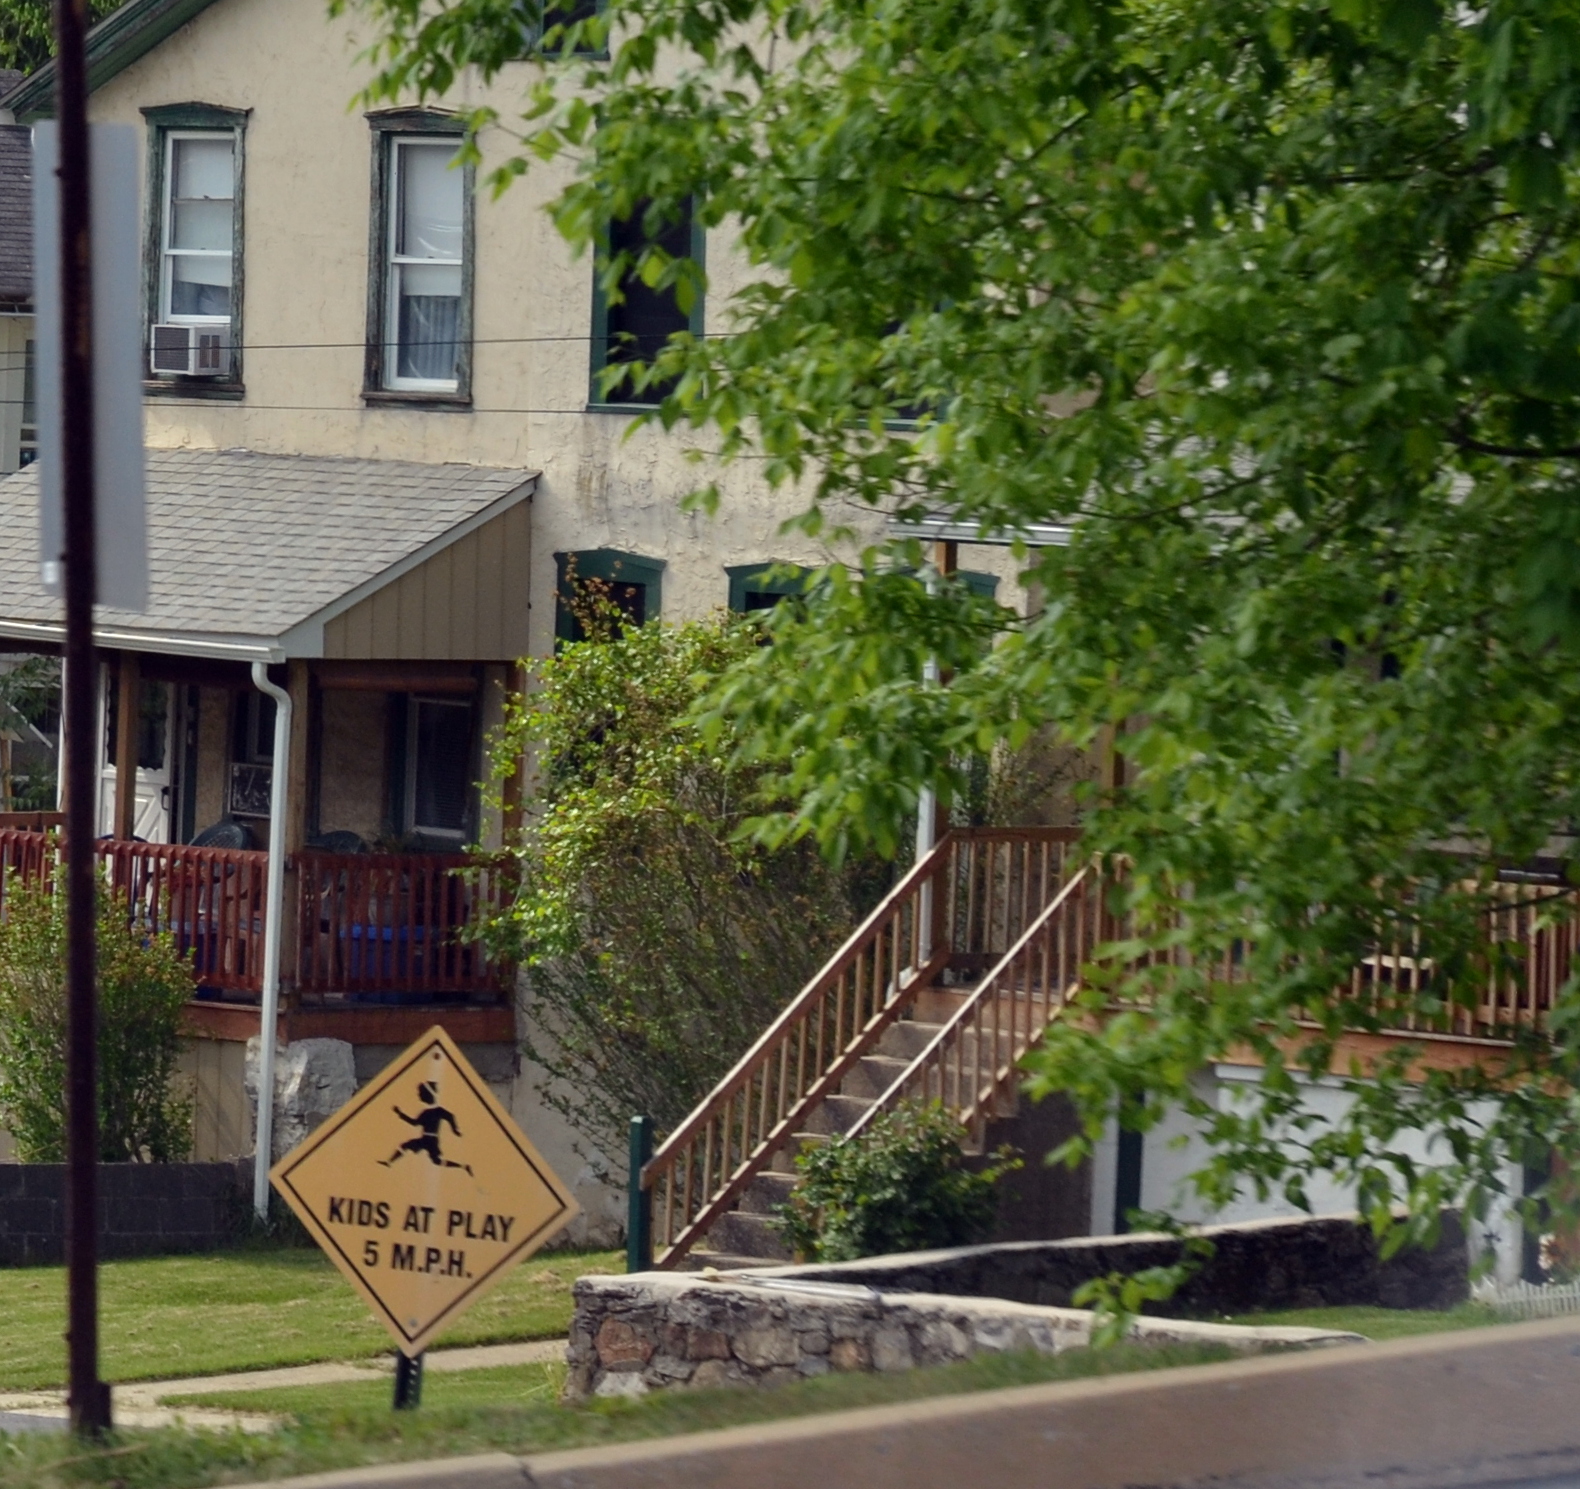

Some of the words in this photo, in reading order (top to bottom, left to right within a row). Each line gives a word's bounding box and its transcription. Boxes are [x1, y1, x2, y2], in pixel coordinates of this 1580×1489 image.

[328, 1196, 391, 1229] KIDS
[403, 1205, 435, 1234] AT
[447, 1209, 515, 1243] PLAY
[363, 1240, 379, 1267] 5
[391, 1243, 473, 1279] M.P.H.
